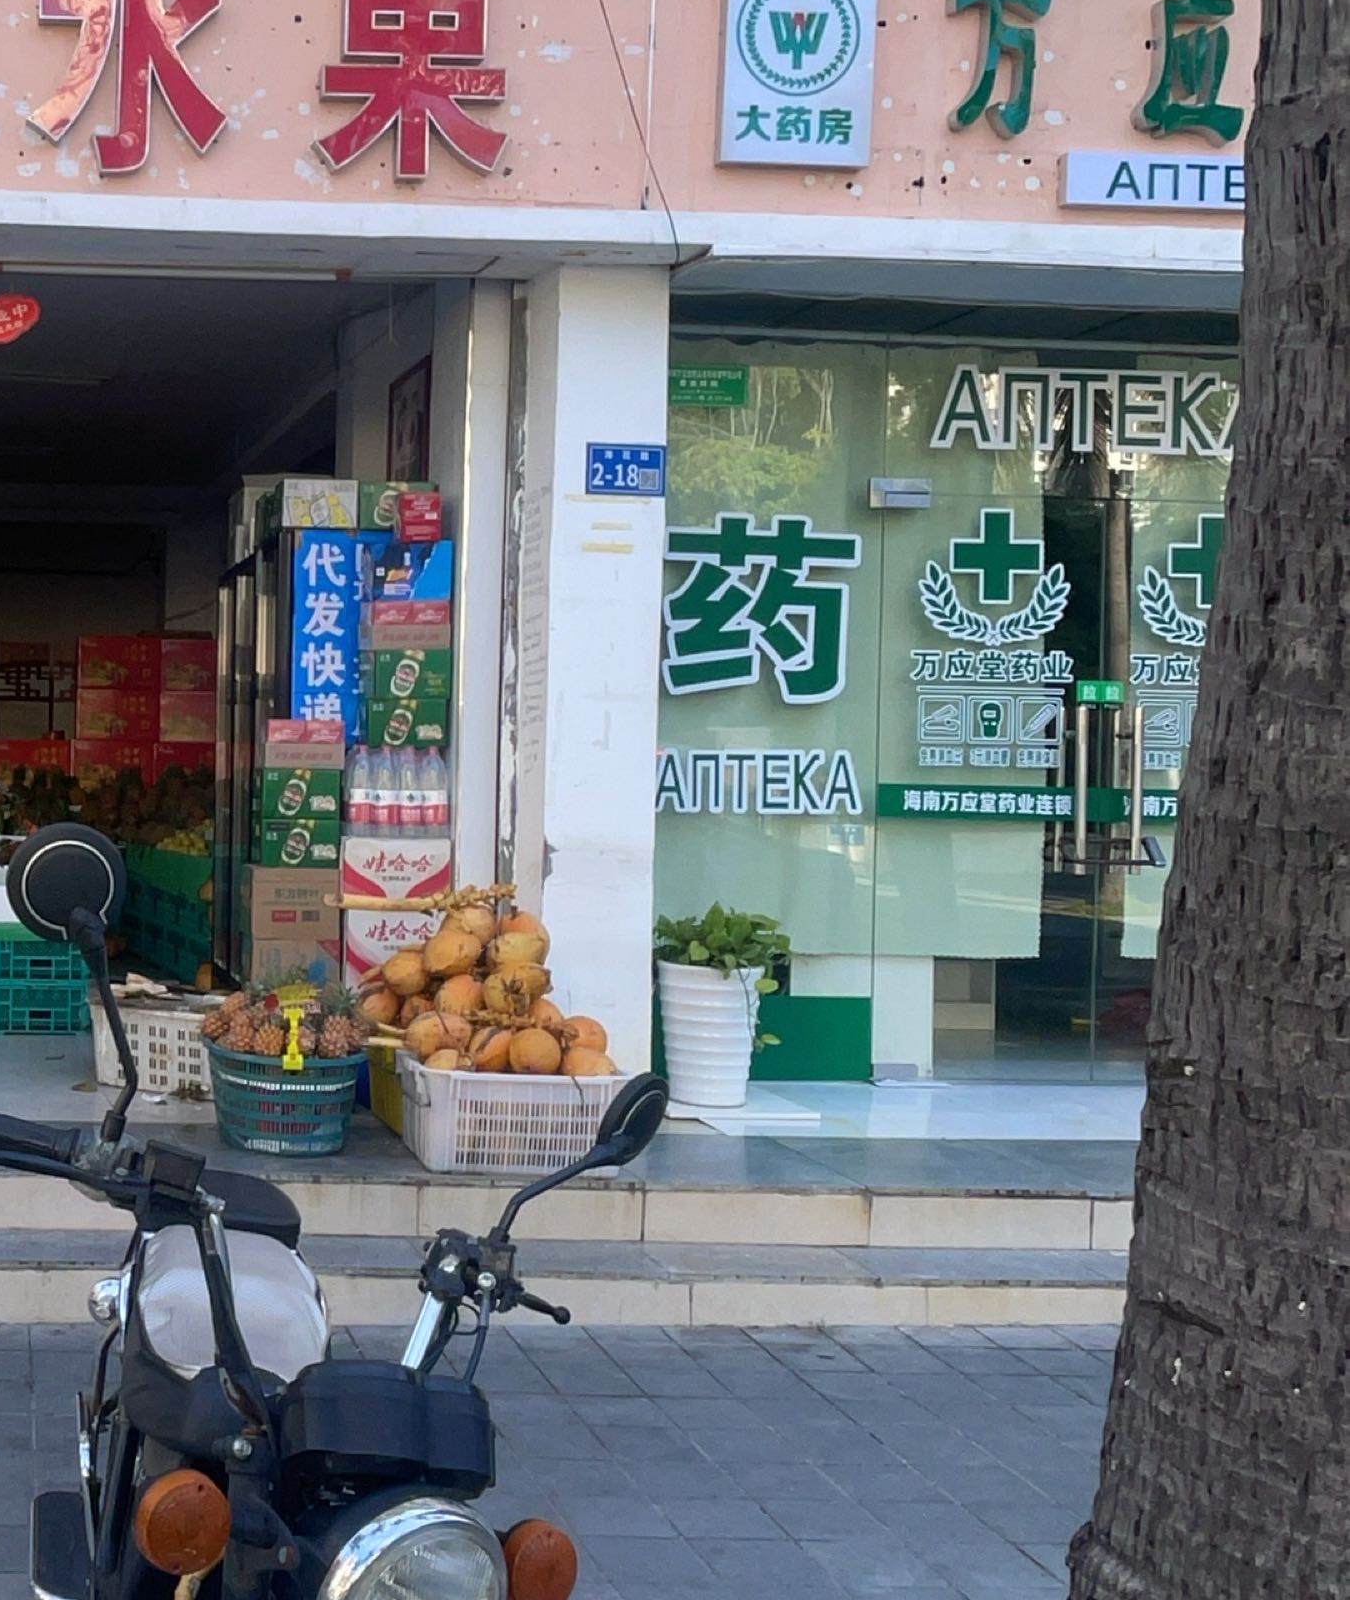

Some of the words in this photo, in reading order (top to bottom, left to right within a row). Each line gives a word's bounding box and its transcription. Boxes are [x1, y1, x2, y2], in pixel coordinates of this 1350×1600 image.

[735, 104, 853, 145] 大药房
[592, 462, 639, 487] 2-18
[664, 512, 862, 704] 药
[909, 648, 1075, 684] 万应堂药业
[1129, 652, 1200, 686] 万应
[655, 748, 863, 815] АПТЕКА
[362, 850, 433, 873] 娃哈哈
[365, 918, 434, 942] 娃哈哈
